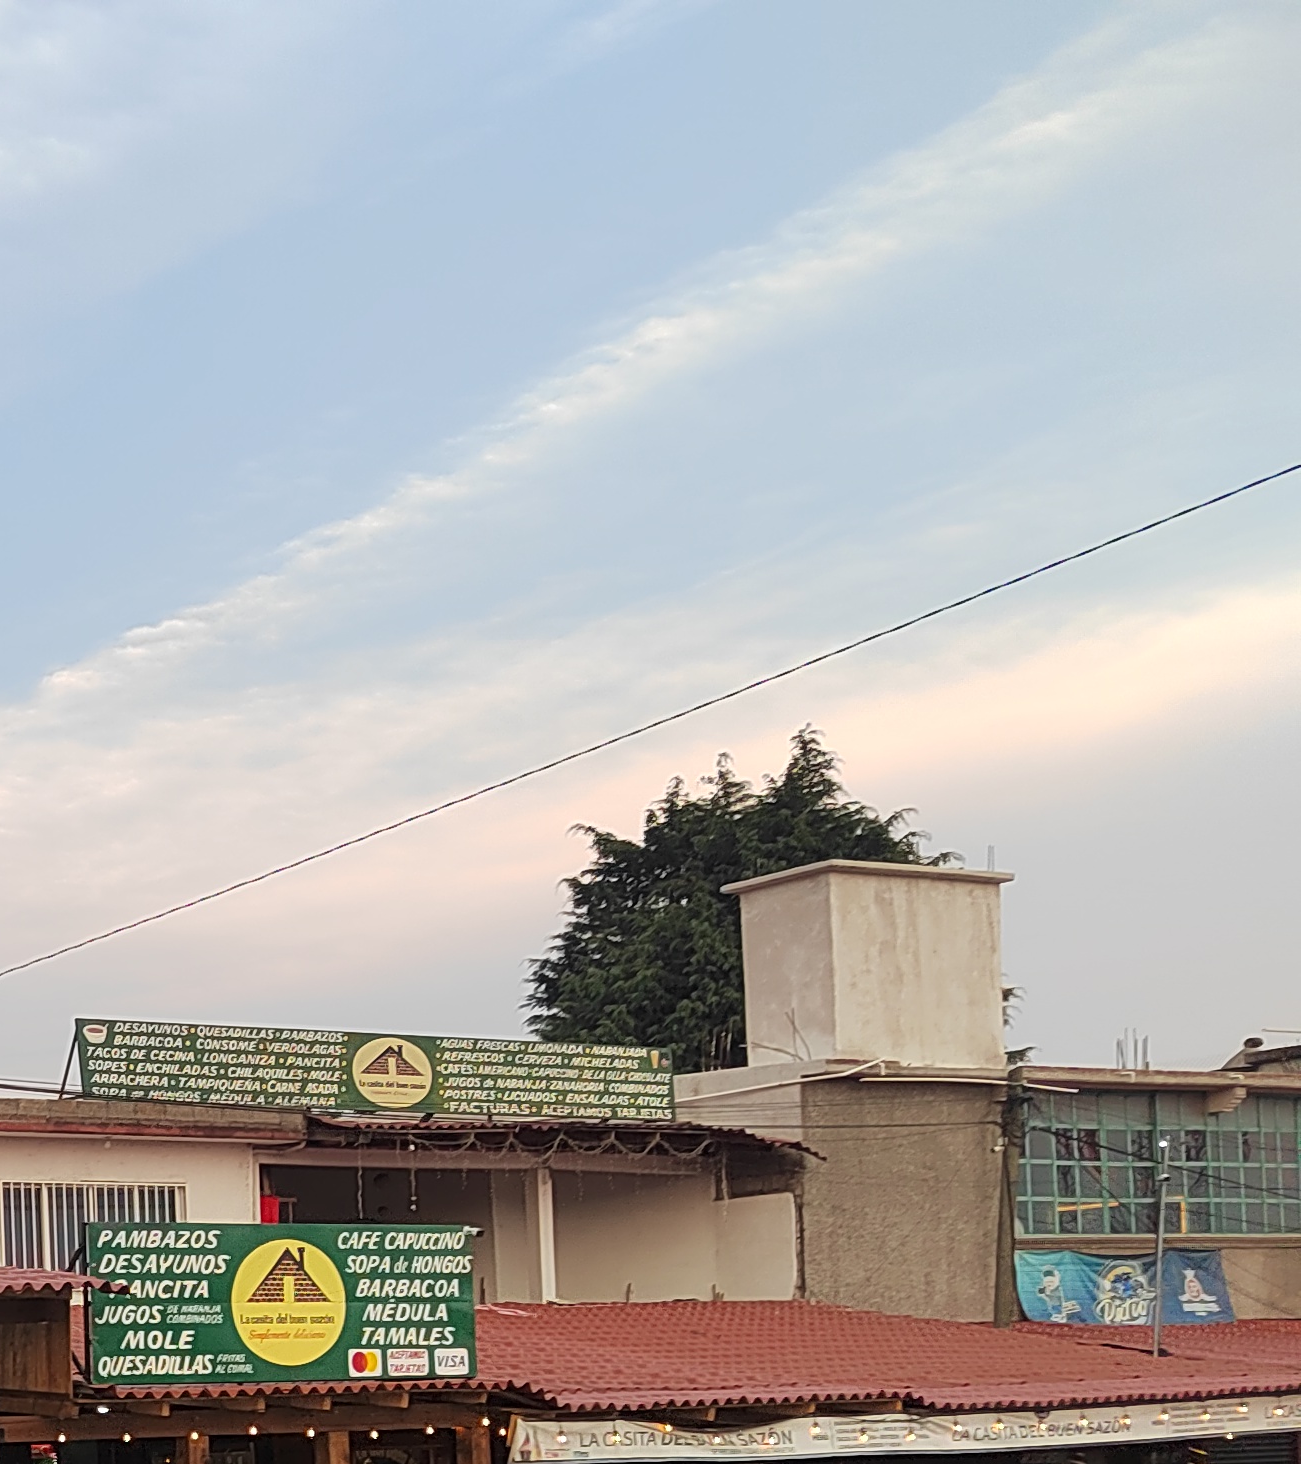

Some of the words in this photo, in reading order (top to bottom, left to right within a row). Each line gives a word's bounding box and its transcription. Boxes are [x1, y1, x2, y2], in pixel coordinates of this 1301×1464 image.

[114, 1022, 189, 1036] DESAYUNOS
[197, 1027, 275, 1040] QUESADILLAS
[282, 1030, 344, 1043] PAMBAZOS
[114, 1035, 183, 1048] BARBACOA
[196, 1039, 257, 1051] CONSOMÉ
[266, 1042, 342, 1056] VERDOLAGAS
[439, 1039, 473, 1051] AGUAS
[476, 1040, 520, 1052] FRESCAS
[527, 1043, 584, 1055] LIMONADA
[86, 1047, 129, 1058] TACOS
[130, 1049, 147, 1059] DE
[150, 1050, 196, 1062] CECINA
[203, 1052, 276, 1065] LONGANIZA
[442, 1051, 504, 1063] REFRESCOS
[515, 1054, 562, 1066] CERVEZA
[569, 1057, 639, 1069] MICHELADAS
[87, 1059, 128, 1072] SOPES
[136, 1062, 218, 1076] ENCHILADAS
[227, 1066, 303, 1080] CHILAQUILES
[308, 1070, 342, 1082] MOLE
[91, 1073, 168, 1087] ARRACHERA
[305, 1083, 339, 1095] ASADA
[443, 1077, 481, 1088] JUGOS
[496, 1078, 546, 1091] NARANJA
[273, 1095, 335, 1107] ALEMANA
[443, 1089, 496, 1101] POSTRES
[503, 1091, 557, 1103] LICUADOS
[565, 1093, 630, 1106] ENSALADAS
[635, 1096, 671, 1107] ATOLE
[449, 1102, 530, 1115] FACTURAS
[97, 1230, 221, 1249] PAMBAZOS
[337, 1231, 381, 1250] CAFE
[384, 1232, 465, 1250] CAPUCCINO
[98, 1254, 231, 1274] DESAYUNOS
[345, 1255, 390, 1274] SOPA
[394, 1255, 408, 1274] de
[410, 1255, 474, 1274] HONGOS
[355, 1279, 460, 1298] BARBACOA
[95, 1305, 164, 1325] JUGOS
[166, 1314, 224, 1324] COMBINADOS
[362, 1298, 448, 1321] MÉDULA
[120, 1330, 195, 1350] MOLE
[360, 1327, 455, 1345] TAMALES
[98, 1354, 214, 1379] QUESADILLAS
[216, 1353, 246, 1363] FRITAS
[437, 1355, 466, 1368] VISA
[579, 1432, 600, 1447] LA
[603, 1431, 657, 1447] CSITA
[737, 1427, 793, 1446] SAZÓN
[952, 1427, 970, 1441] LA
[1048, 1422, 1084, 1437] BUEN
